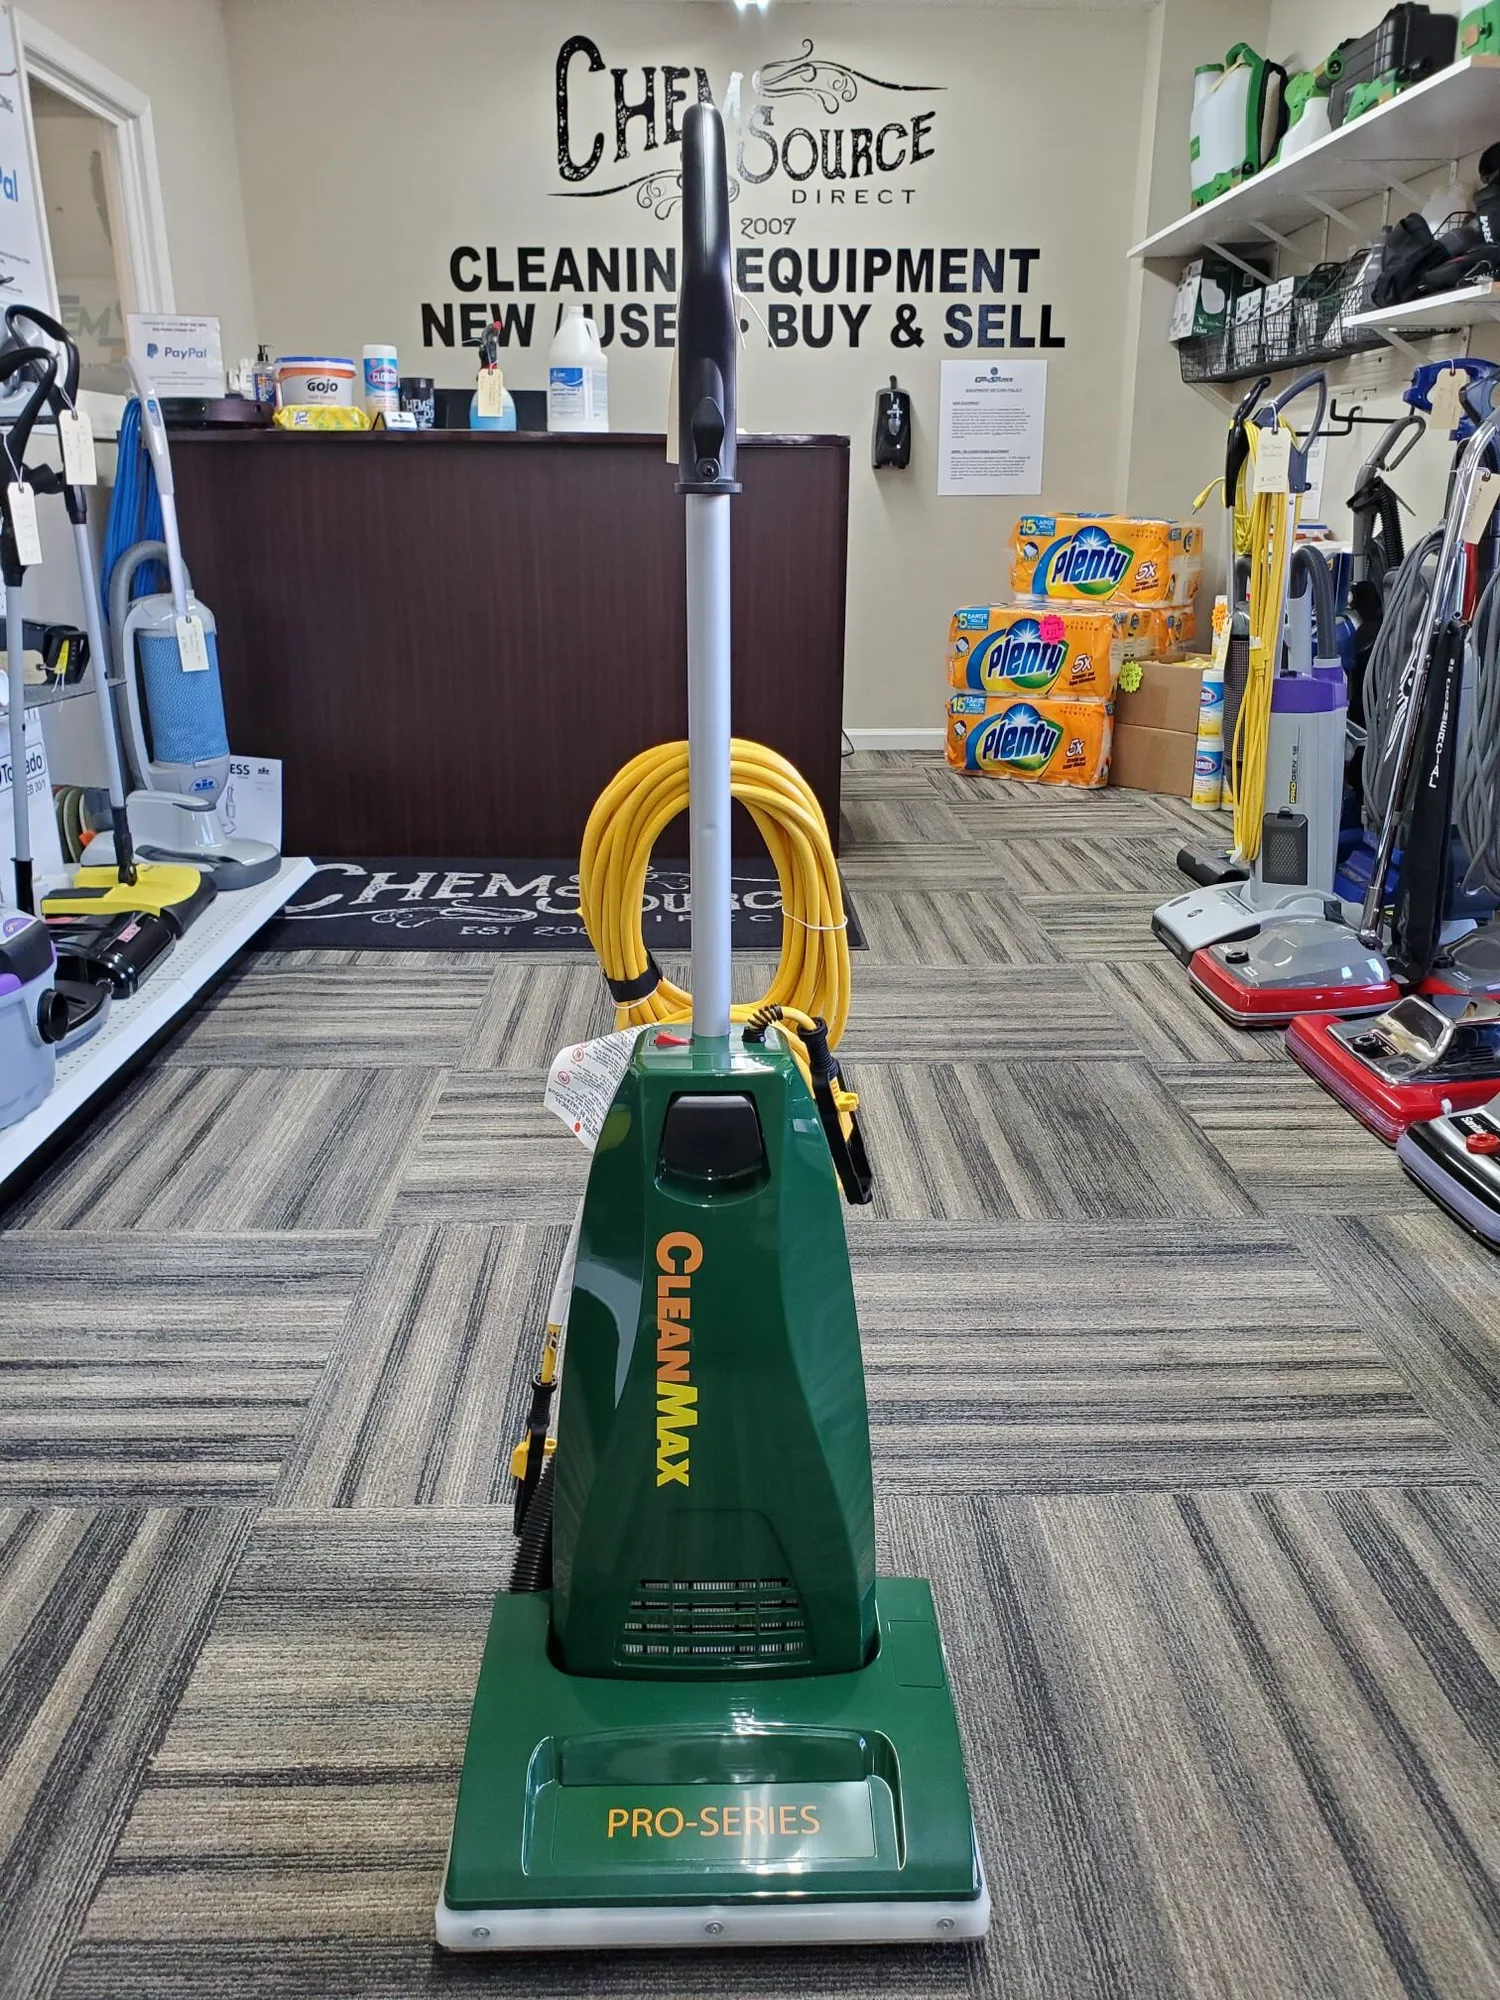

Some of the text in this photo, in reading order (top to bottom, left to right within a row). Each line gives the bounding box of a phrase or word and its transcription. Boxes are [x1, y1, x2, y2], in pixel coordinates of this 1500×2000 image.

[0, 166, 18, 202] al
[791, 189, 916, 204] DIRECT
[741, 217, 797, 239] 2007
[450, 246, 1040, 297] CLEANIN EQUIPMENT
[421, 303, 535, 347] NEW
[583, 303, 677, 348] USE
[768, 304, 872, 348] BUY
[890, 303, 924, 348] &
[944, 303, 1066, 348] SELL
[164, 346, 208, 360] PayPal
[1051, 542, 1128, 584] Plenty
[987, 636, 1066, 680] Plenty
[983, 721, 1058, 761] Plenty
[1428, 678, 1451, 788] COMMERCIAL
[459, 925, 517, 936] EST
[656, 1231, 704, 1487] CLEANMAX
[608, 1805, 821, 1838] PRO-SERIES
